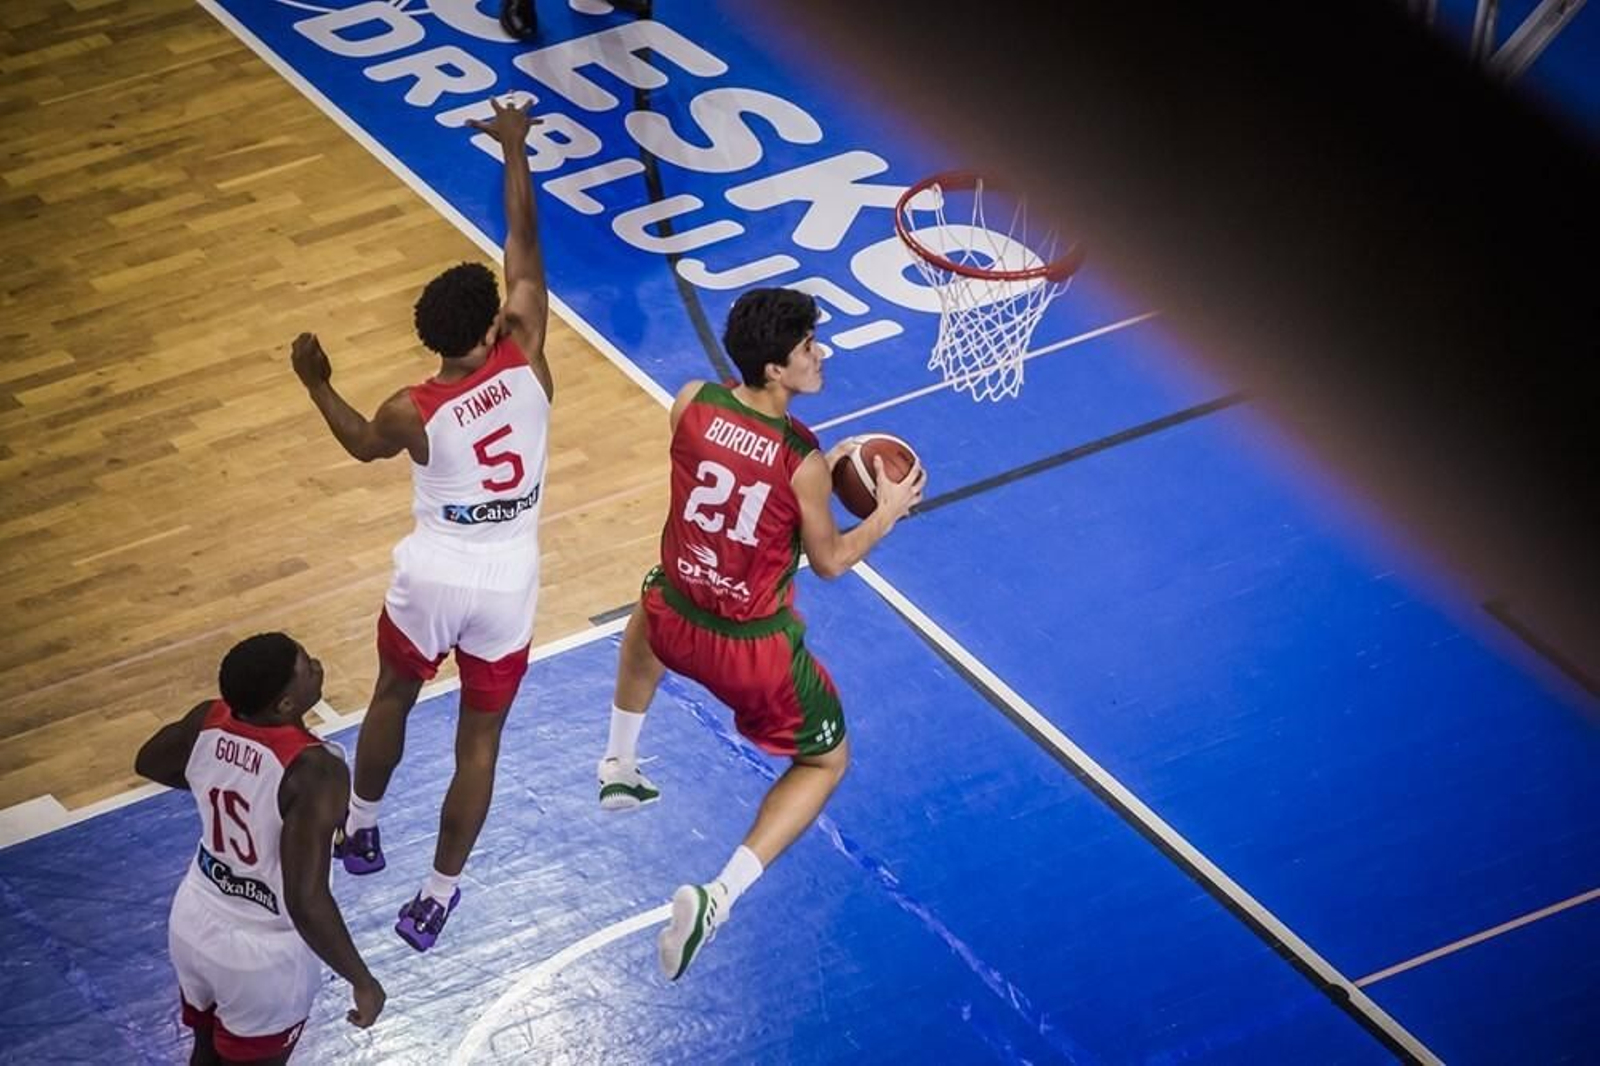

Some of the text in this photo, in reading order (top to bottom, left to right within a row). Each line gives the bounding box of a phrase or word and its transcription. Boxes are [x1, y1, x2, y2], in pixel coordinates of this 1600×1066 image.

[453, 379, 512, 427] P.TAMBA
[473, 424, 525, 493] 5
[704, 417, 780, 467] BORDEN
[683, 460, 772, 547] 21
[209, 787, 257, 866] 15
